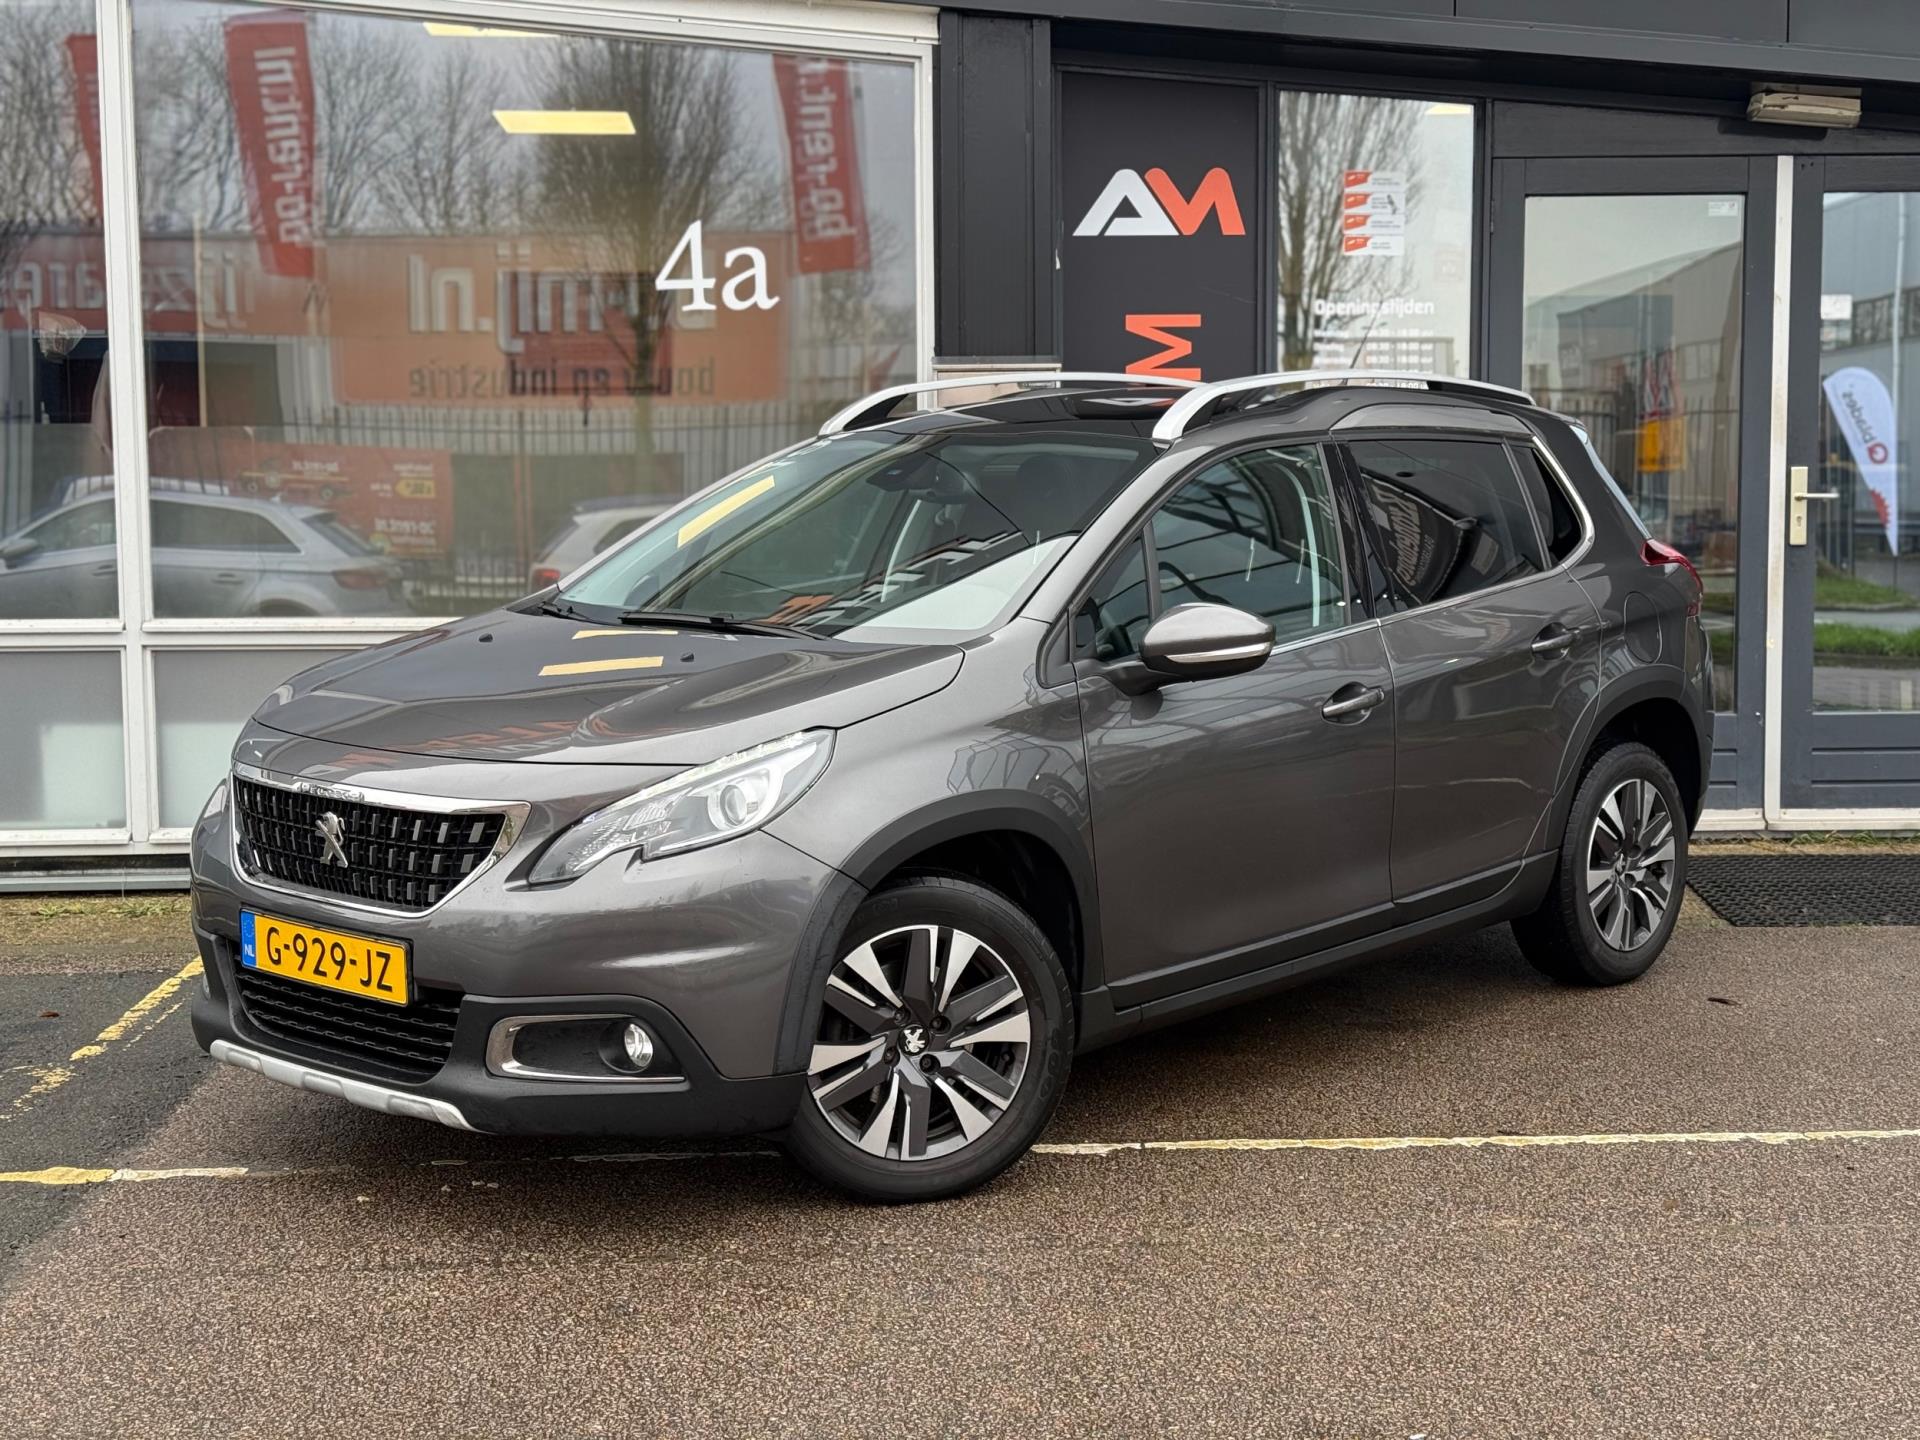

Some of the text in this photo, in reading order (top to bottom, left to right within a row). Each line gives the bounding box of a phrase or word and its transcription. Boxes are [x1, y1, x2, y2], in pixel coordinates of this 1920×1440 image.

[1072, 168, 1246, 236] AM
[655, 219, 780, 311] 4a
[1314, 299, 1435, 317] Openingstijden
[244, 943, 255, 957] NL
[266, 926, 393, 992] G-929-JZ
